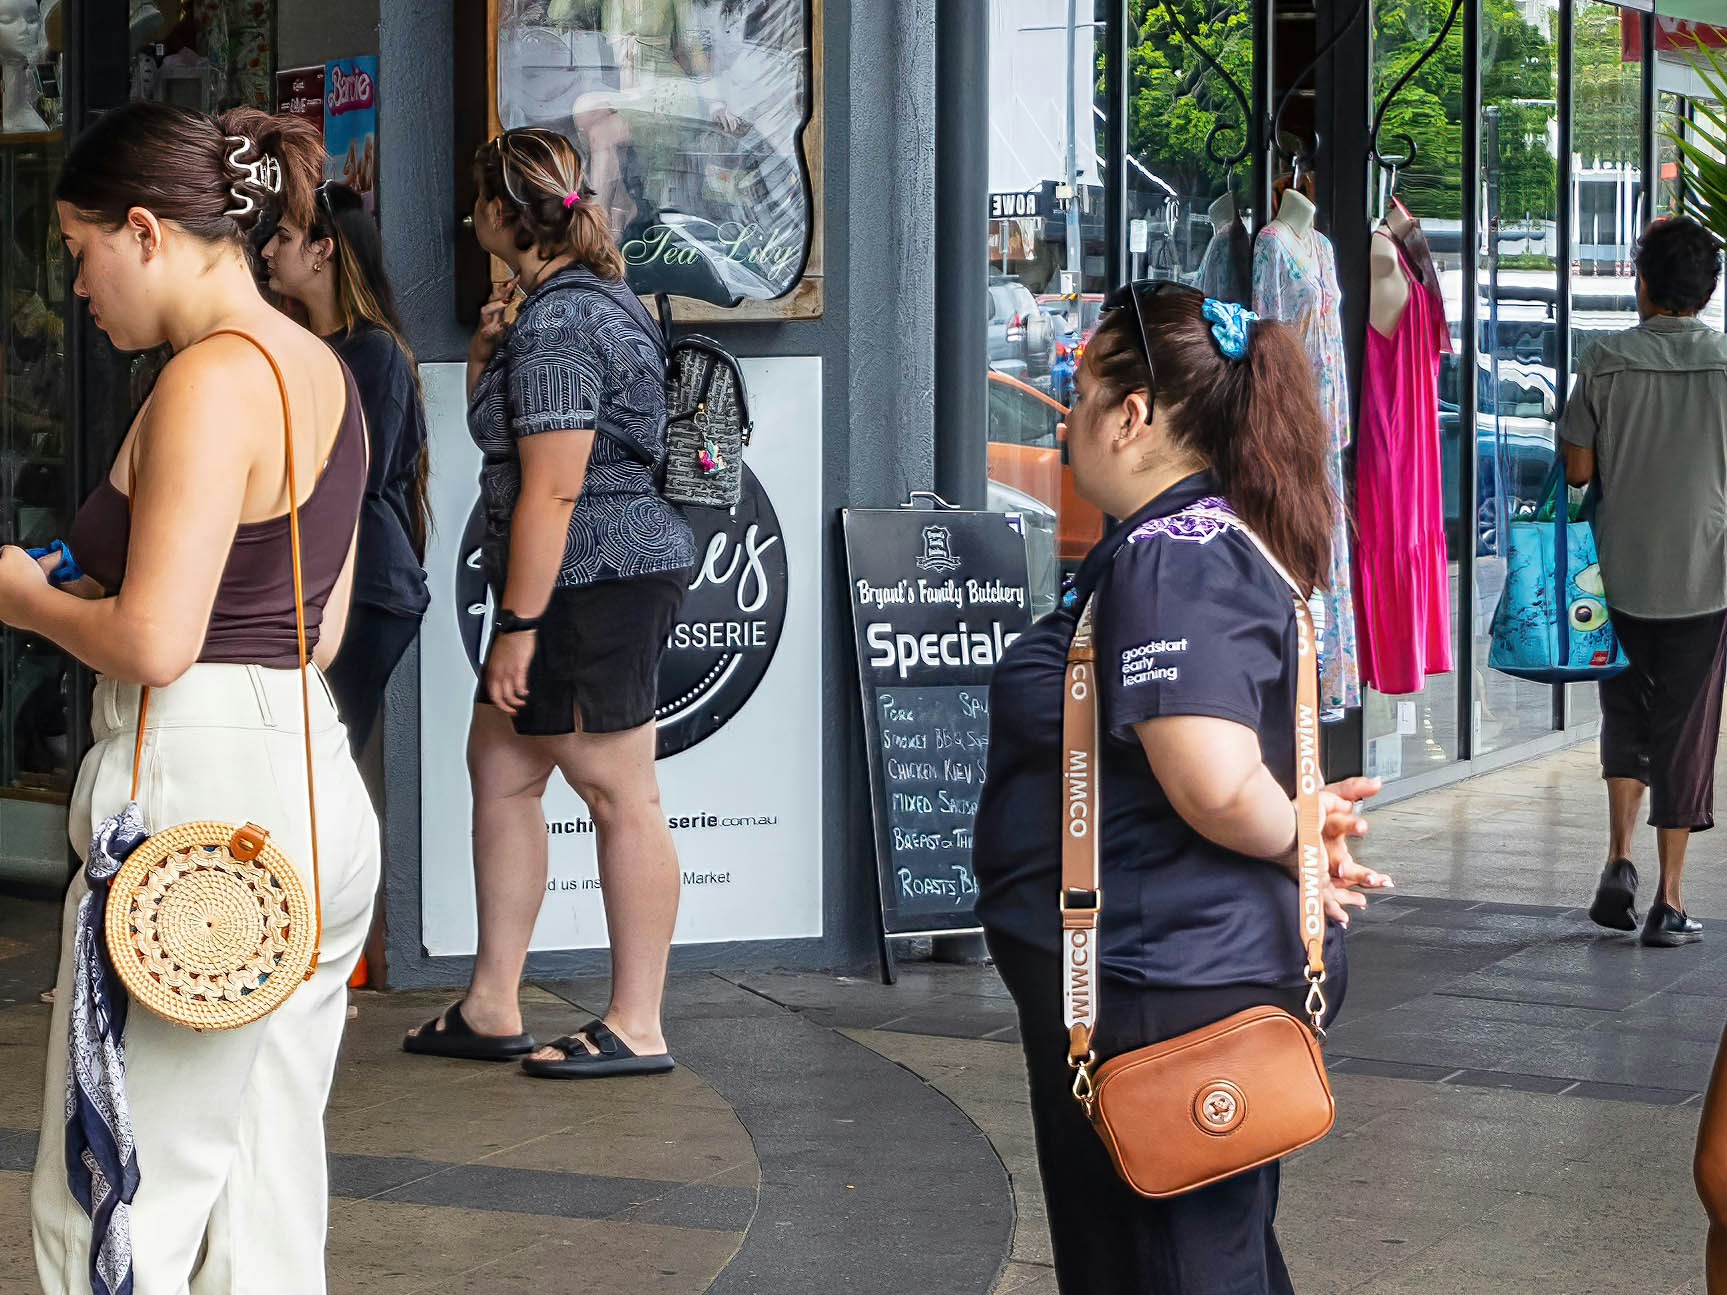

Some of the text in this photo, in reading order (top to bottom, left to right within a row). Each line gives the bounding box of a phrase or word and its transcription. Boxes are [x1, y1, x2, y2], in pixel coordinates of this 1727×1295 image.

[621, 224, 698, 266] Tea
[856, 579, 1024, 609] Bryant's Family Butchery
[1122, 638, 1187, 663] goodstart
[1122, 657, 1154, 673] early
[1123, 667, 1178, 687] learning
[561, 871, 731, 891] us Market
